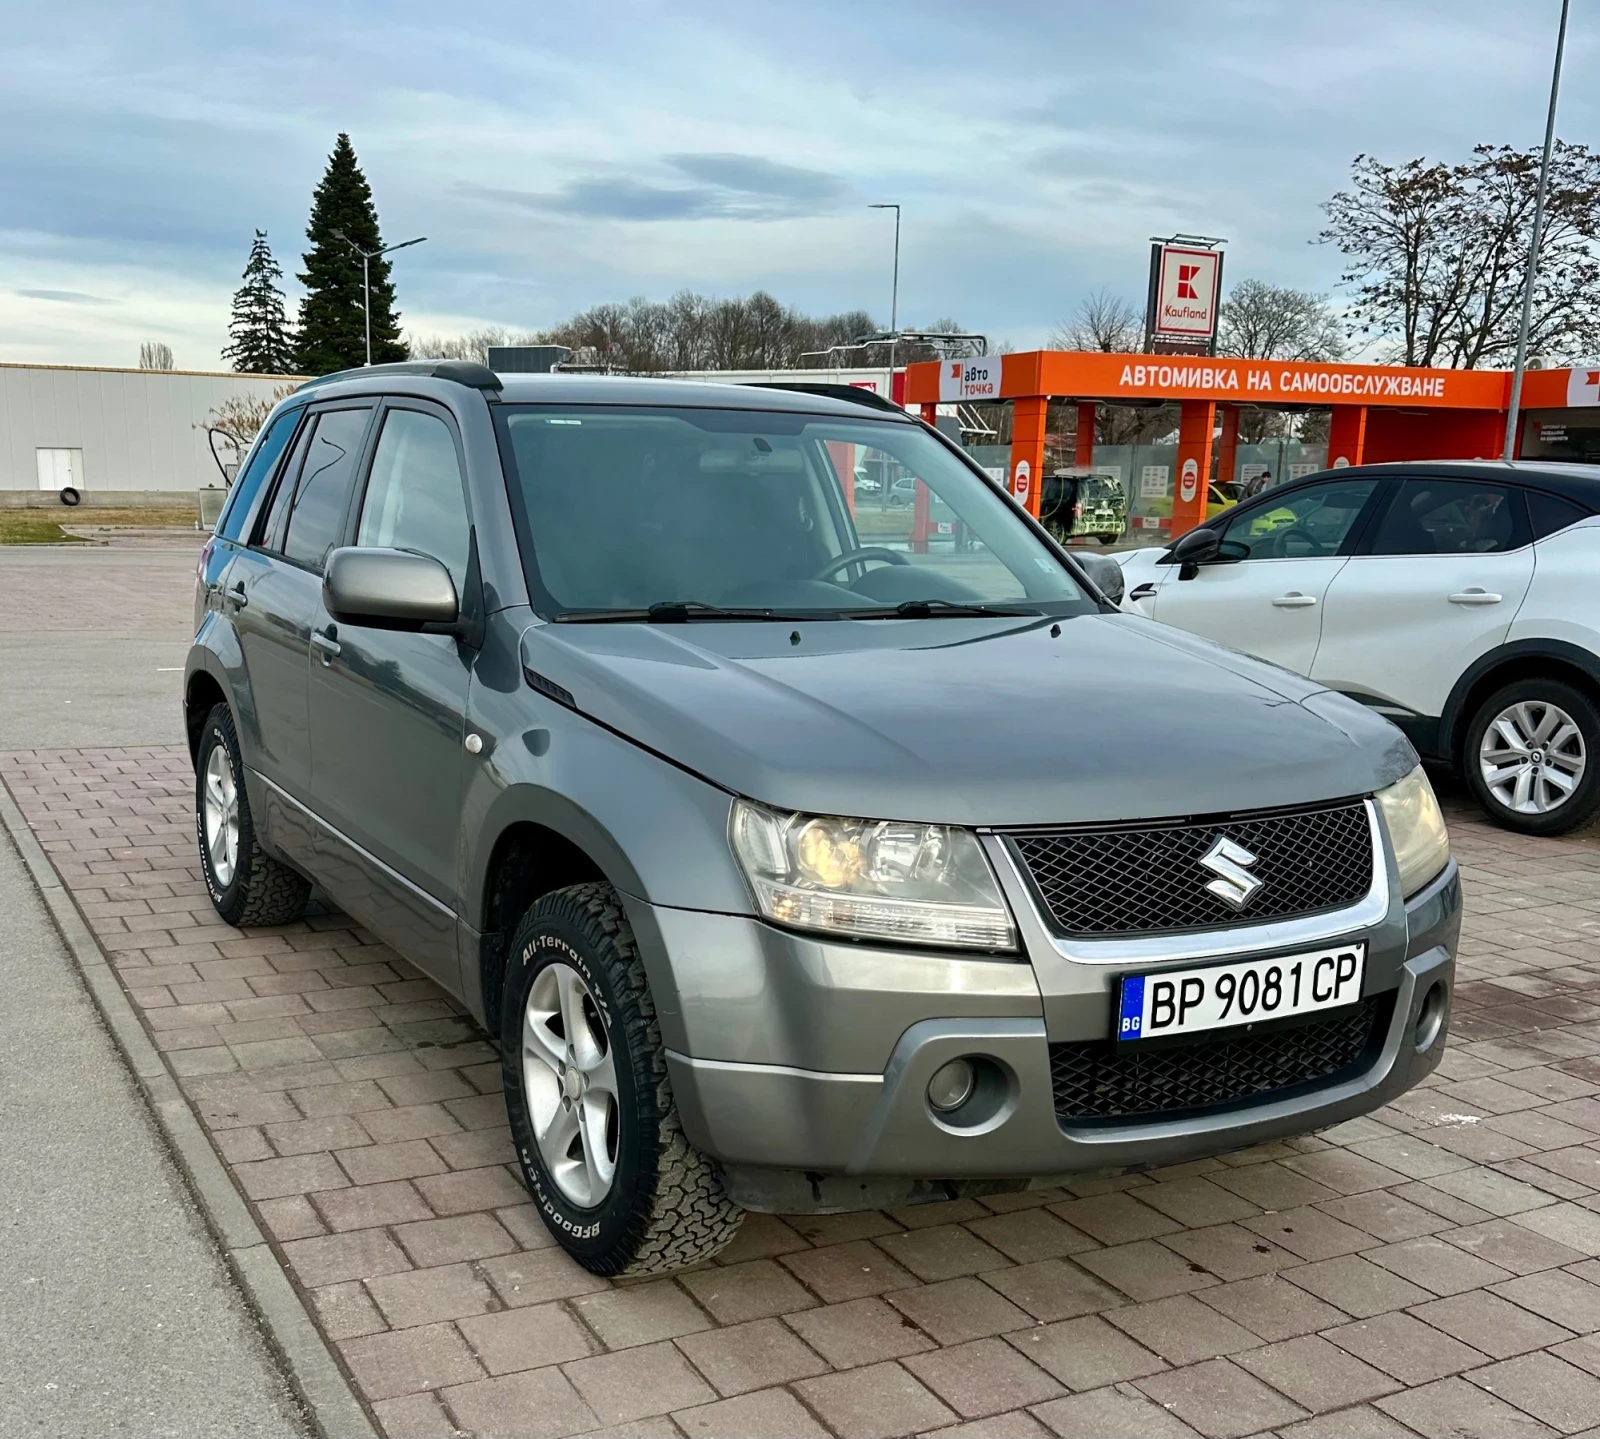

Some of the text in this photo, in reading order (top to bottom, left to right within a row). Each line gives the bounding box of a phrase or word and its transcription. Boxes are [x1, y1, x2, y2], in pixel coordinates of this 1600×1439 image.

[1165, 305, 1207, 320] Kaufland
[964, 366, 989, 382] авто
[1119, 365, 1446, 397] АВТОМИВКА НА САМООБСЛУЖВАНЕ
[964, 382, 994, 395] точка
[522, 935, 591, 980] All-Terrain
[1150, 952, 1357, 1030] BP 9081 CP
[1121, 1016, 1141, 1032] BG
